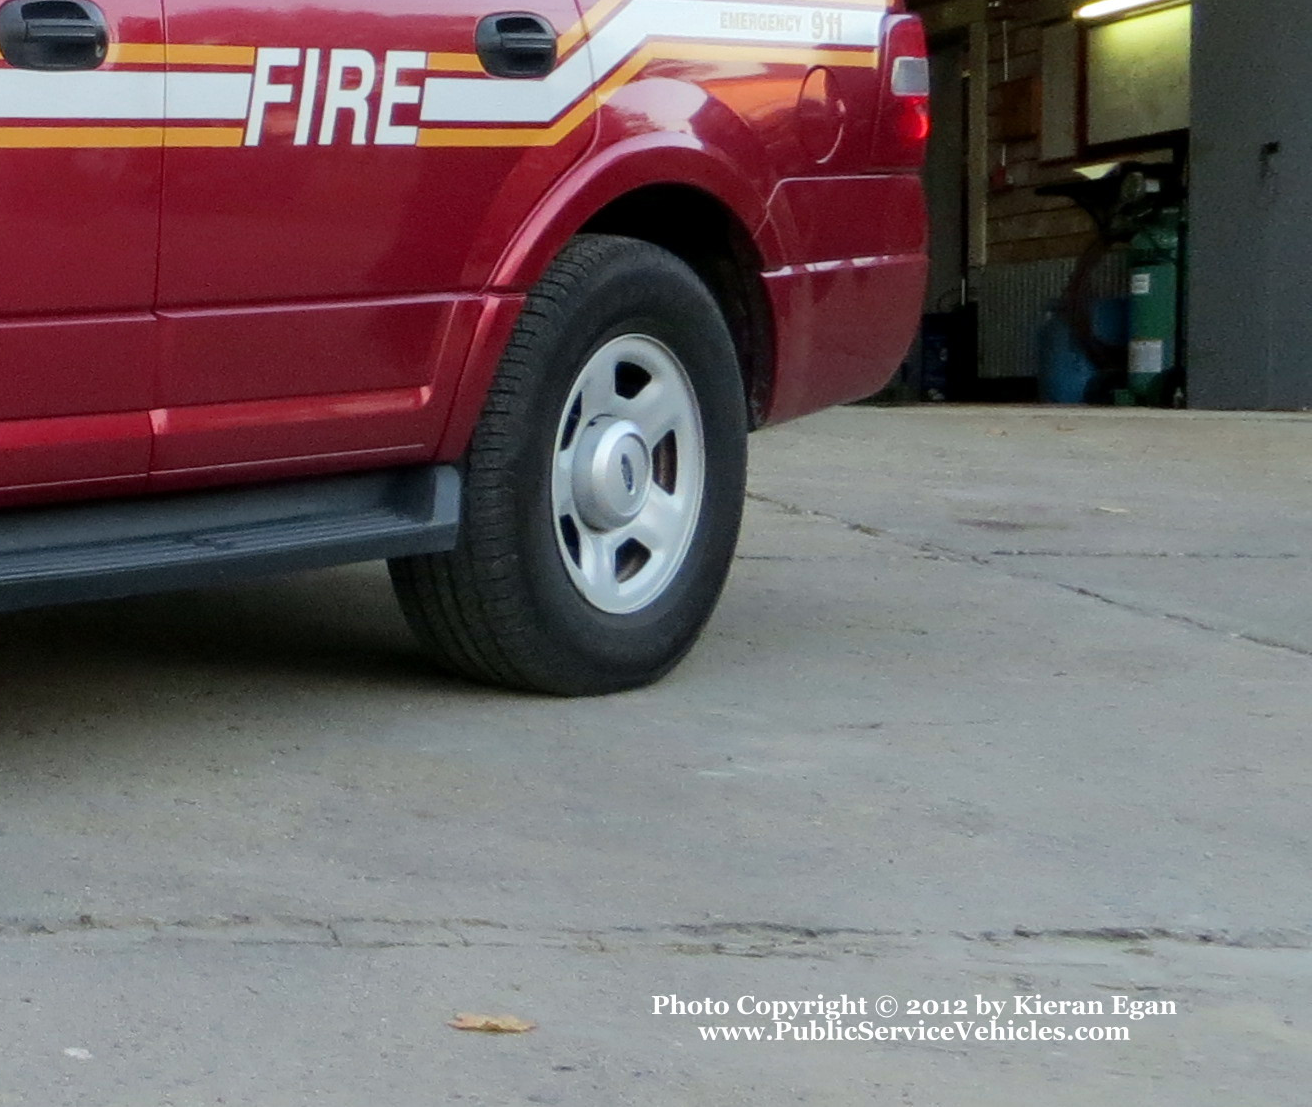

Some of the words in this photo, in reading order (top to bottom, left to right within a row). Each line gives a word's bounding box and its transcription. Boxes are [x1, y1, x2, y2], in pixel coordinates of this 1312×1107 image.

[719, 11, 803, 32] EMERGENCY
[810, 9, 843, 42] 911
[244, 47, 427, 146] FIRE
